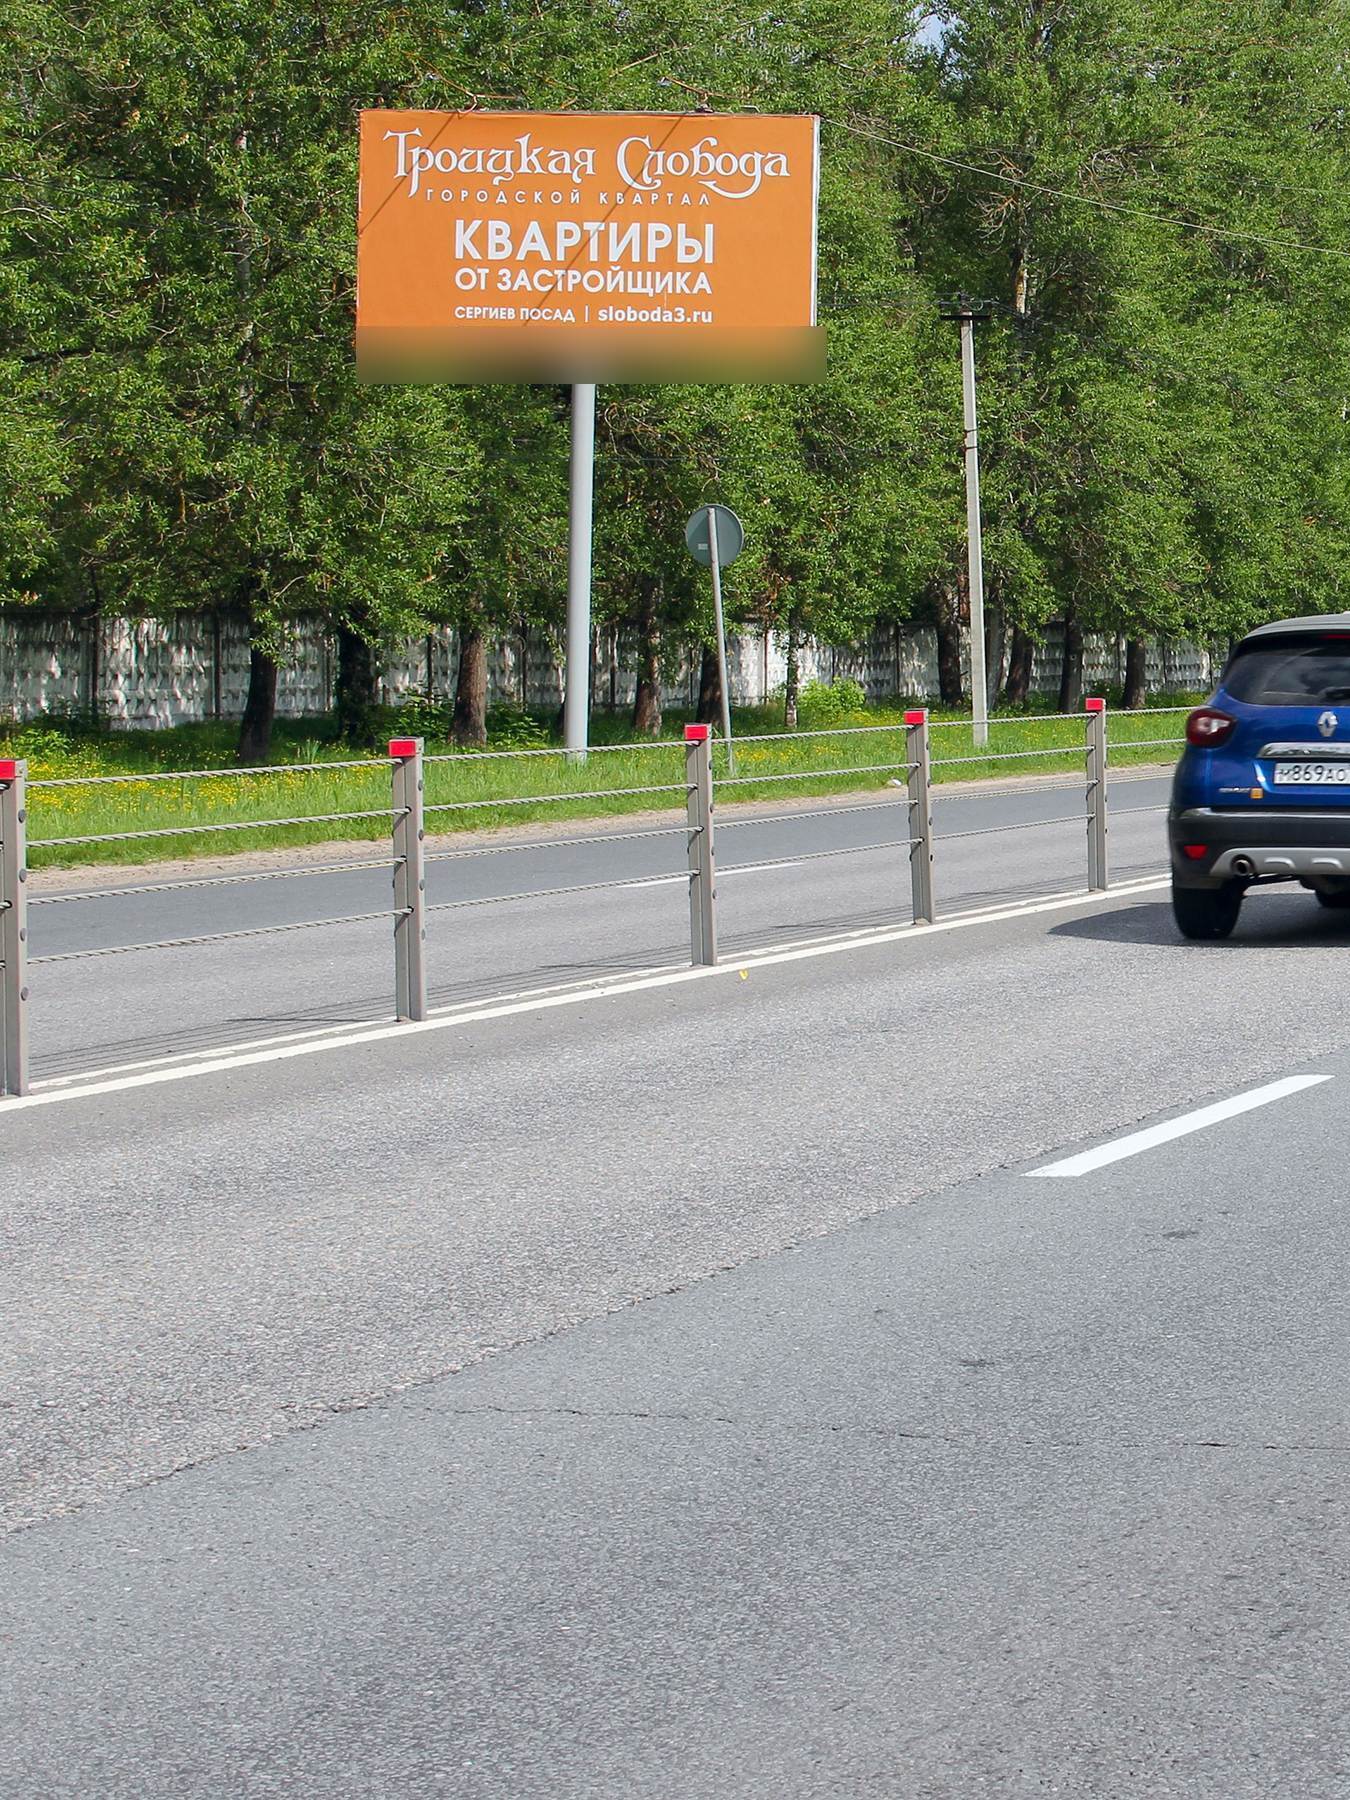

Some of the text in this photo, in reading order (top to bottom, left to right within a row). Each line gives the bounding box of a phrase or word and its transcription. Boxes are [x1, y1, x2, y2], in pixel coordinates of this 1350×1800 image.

[383, 127, 790, 198] Троицкая Слобода
[427, 188, 710, 205] ГОРОДСКОЙ КВАРТАЛ
[454, 219, 714, 264] КВАРТИРЫ
[455, 265, 712, 297] ОТ ЗАСТРОЙЩИКА
[454, 306, 576, 322] СЕРГИЕВ ПОСАД
[598, 306, 713, 323] sloboda3.ru
